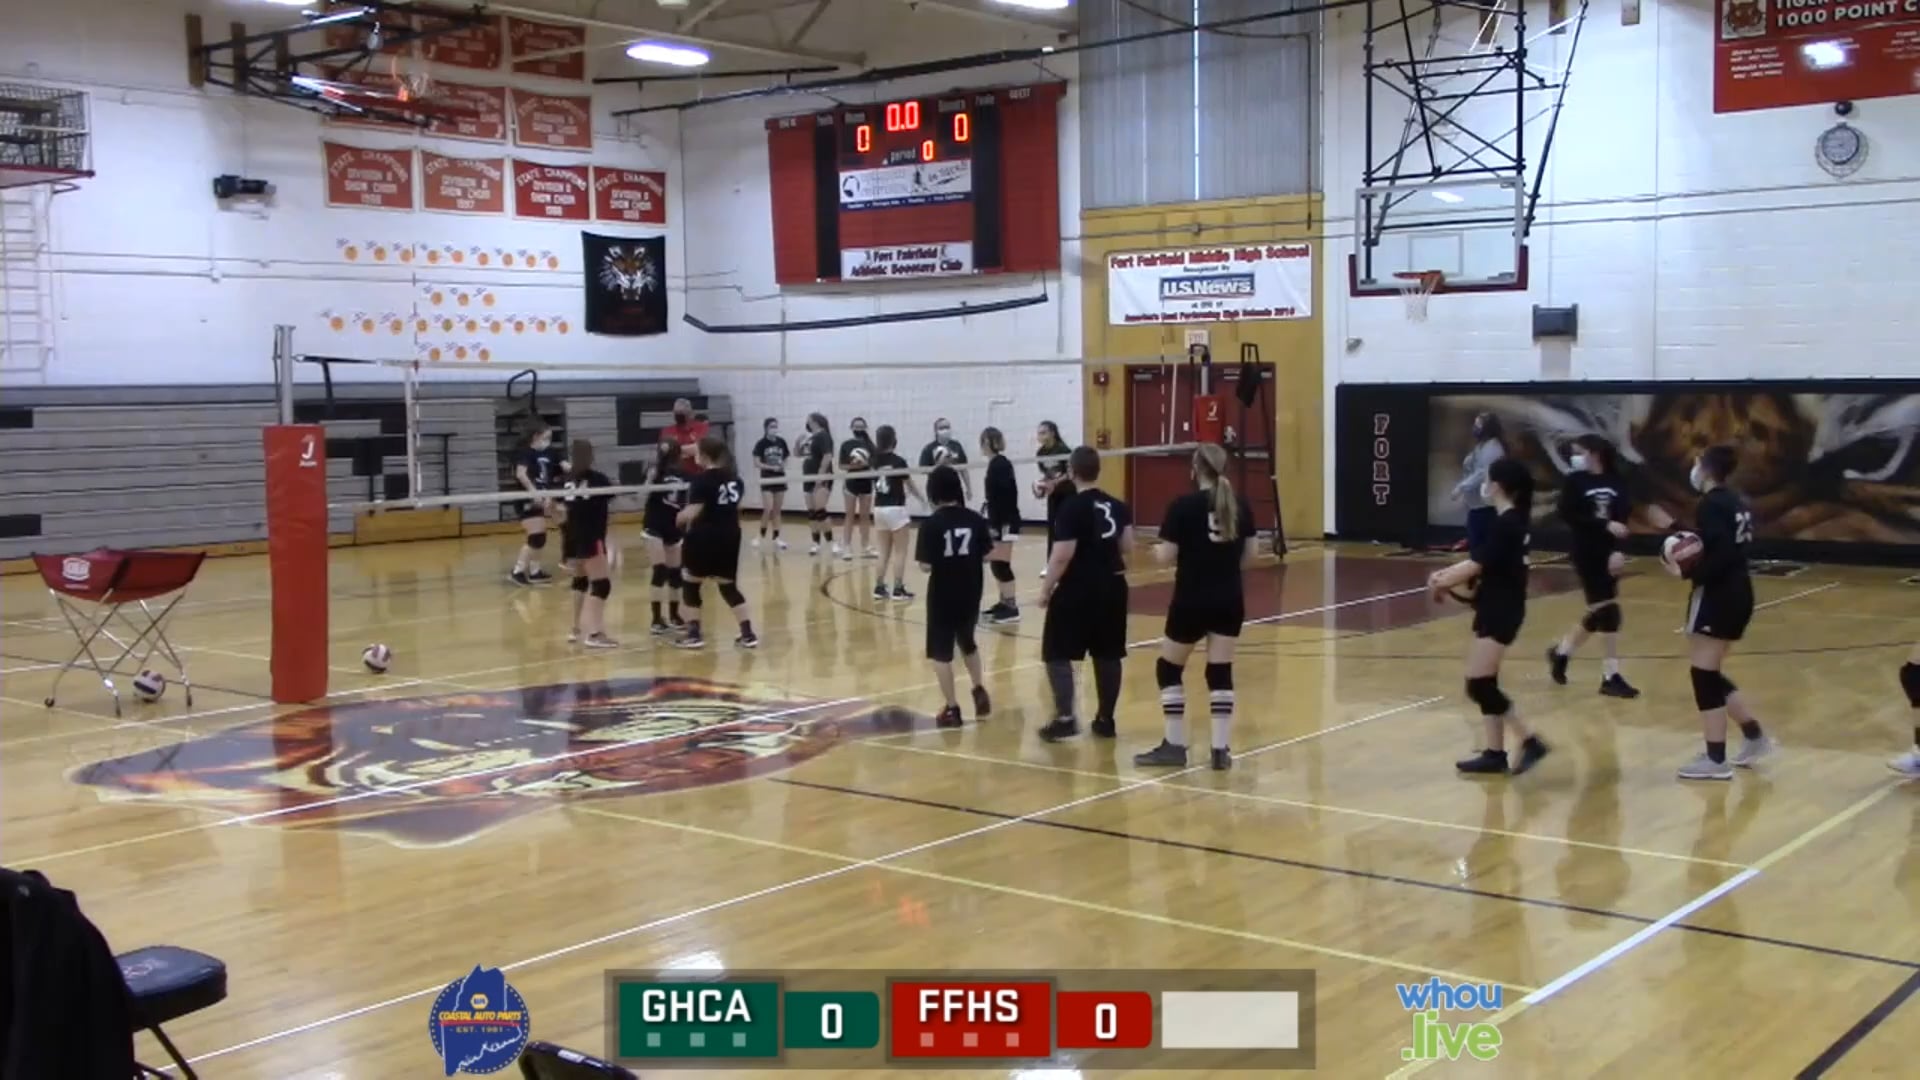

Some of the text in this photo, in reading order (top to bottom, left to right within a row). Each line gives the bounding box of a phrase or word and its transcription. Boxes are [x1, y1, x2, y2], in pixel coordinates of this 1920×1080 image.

[1777, 9, 1827, 27] 1000
[1834, 1, 1897, 21] POINT
[887, 101, 920, 131] 0.0
[954, 113, 969, 142] 0
[857, 125, 870, 152] 0
[922, 140, 935, 161] 0
[516, 168, 588, 191] STATE CHAMPIONS
[533, 181, 564, 192] DIVISION
[596, 172, 619, 191] STATE
[874, 247, 938, 263] Fort Fairfield
[891, 263, 936, 275] Boosters
[940, 259, 964, 272] Club
[1111, 245, 1310, 269] Fort Fairfield Middle High School
[1373, 413, 1390, 505] FORT
[717, 480, 740, 505] 25
[1094, 501, 1117, 539] 3
[943, 527, 973, 558] 17
